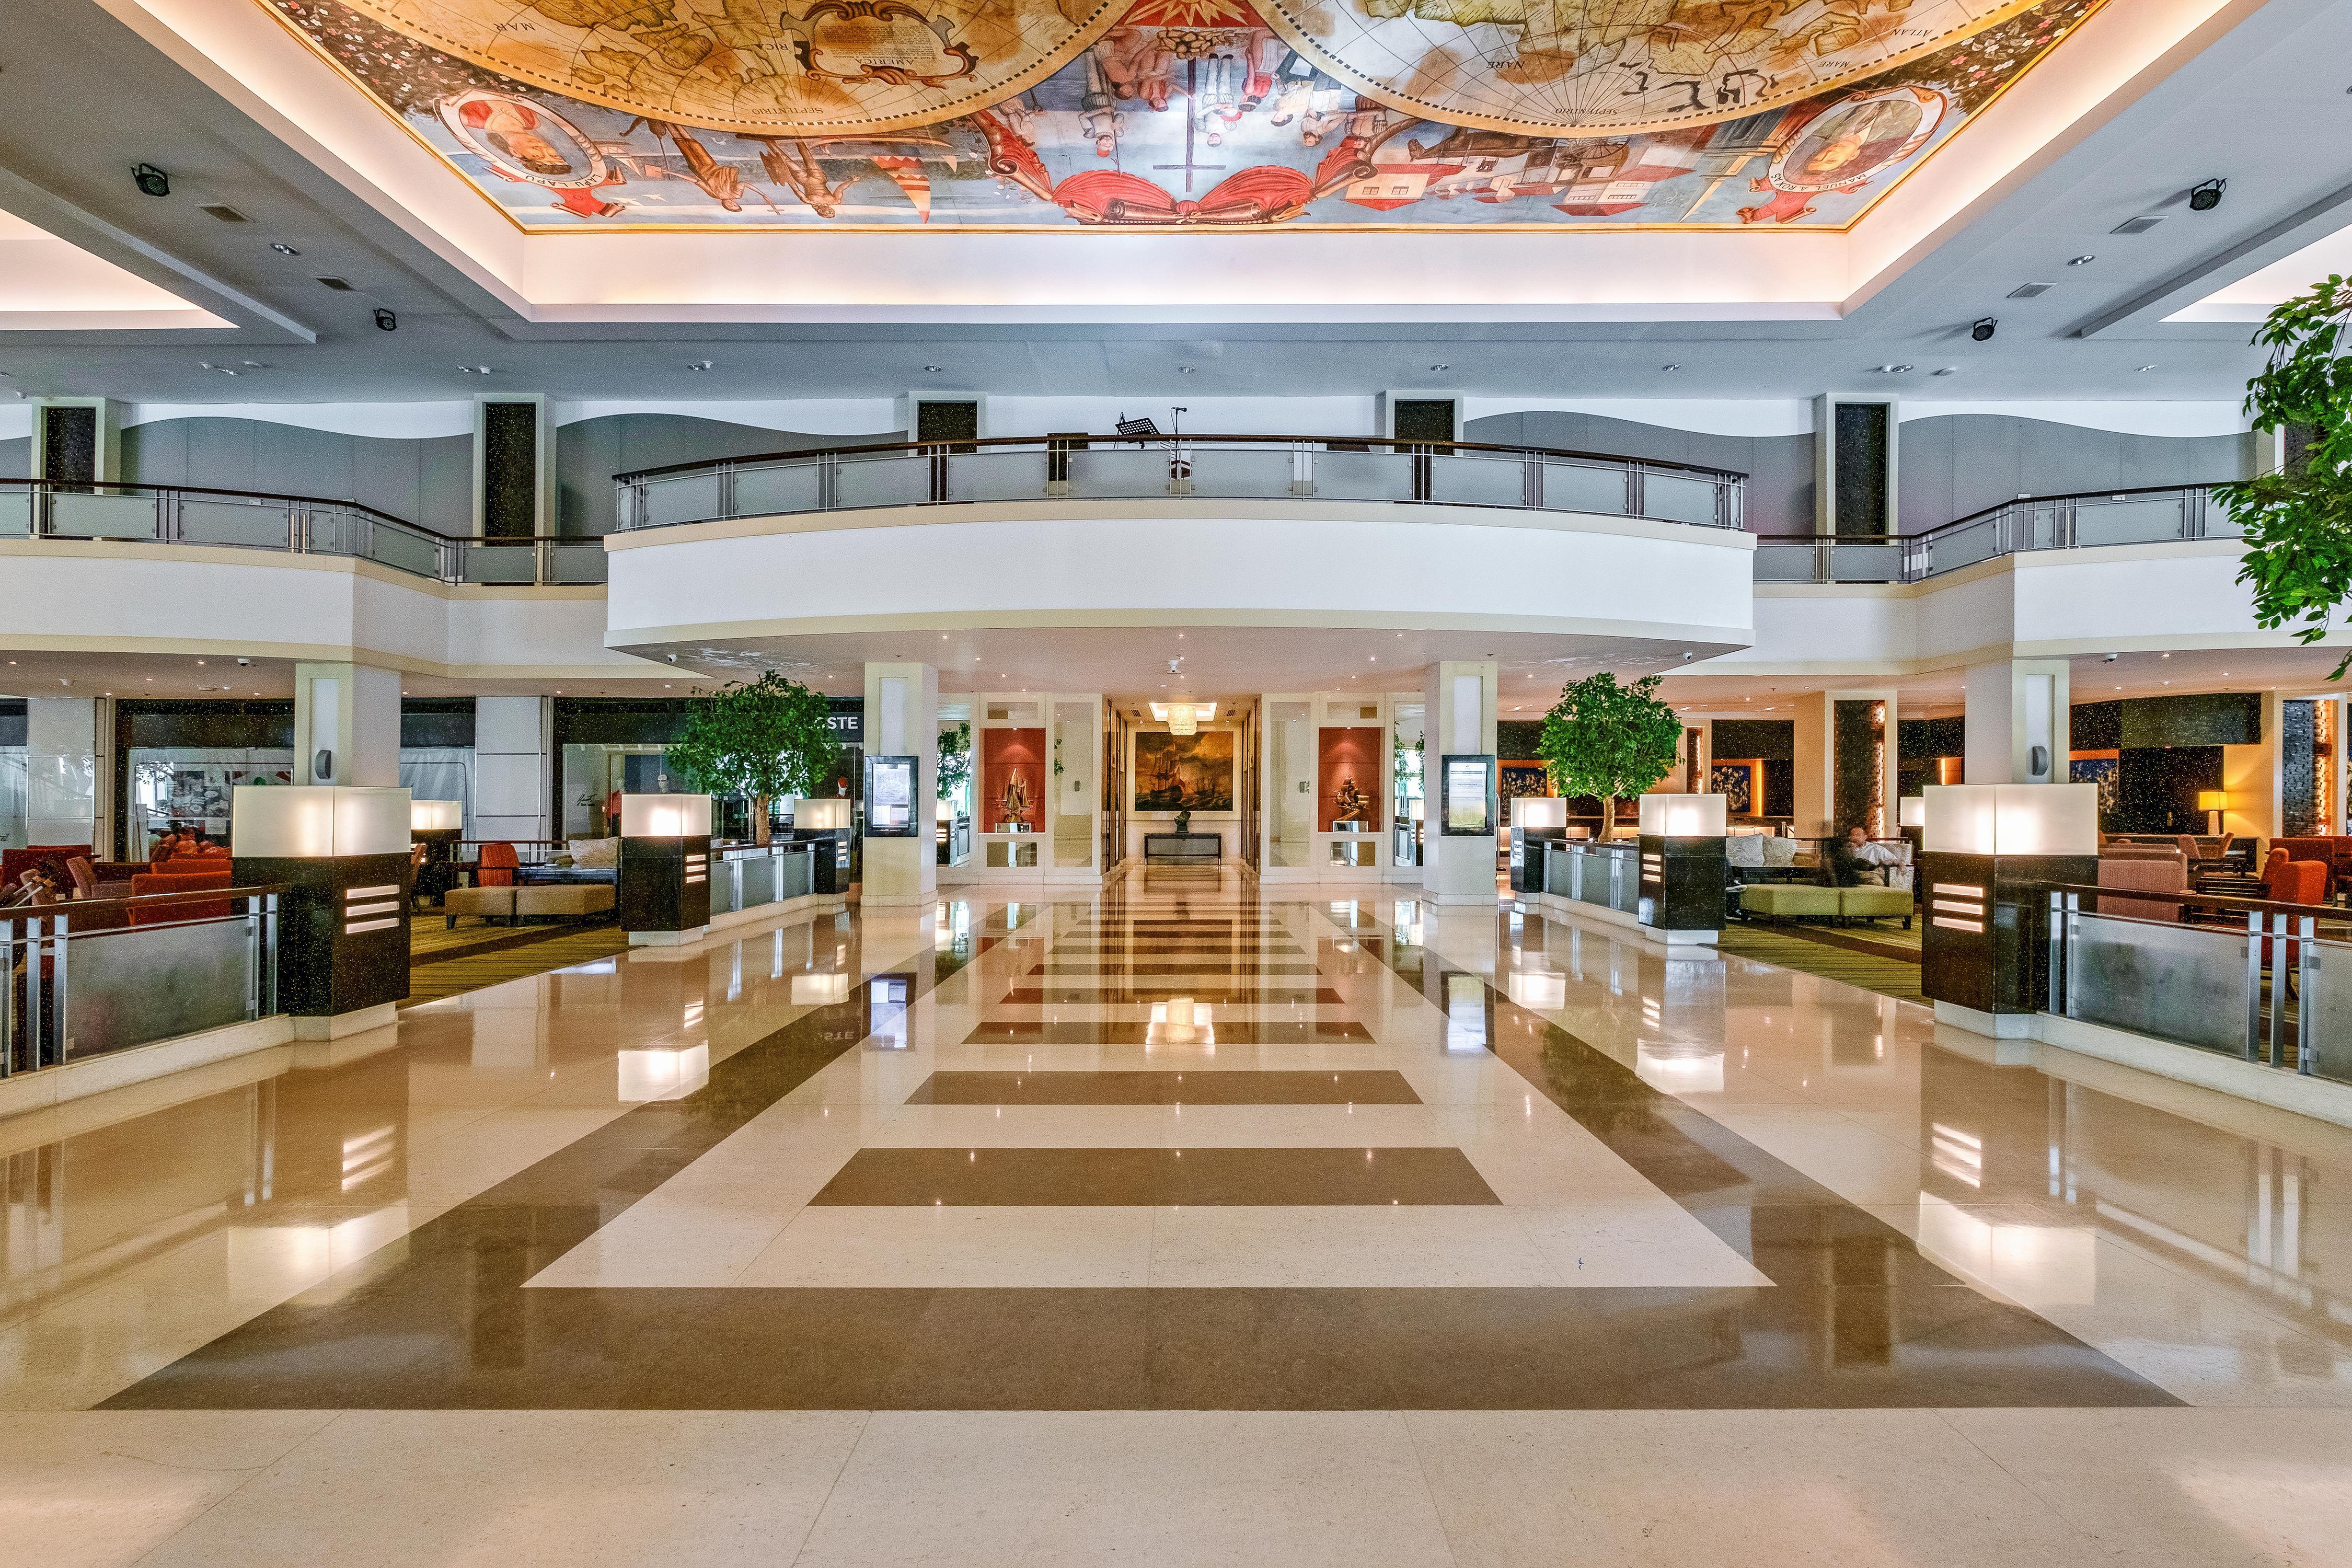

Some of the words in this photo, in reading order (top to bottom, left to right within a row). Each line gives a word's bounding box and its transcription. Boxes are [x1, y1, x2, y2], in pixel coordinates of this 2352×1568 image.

[493, 23, 536, 31] MAR
[1889, 29, 1933, 38] ATLAN
[1817, 60, 1851, 68] MARE
[525, 175, 569, 188] LAPU
[575, 174, 602, 187] LAPU
[1771, 173, 1796, 190] ROXAS
[1816, 174, 1866, 190] MANUEL
